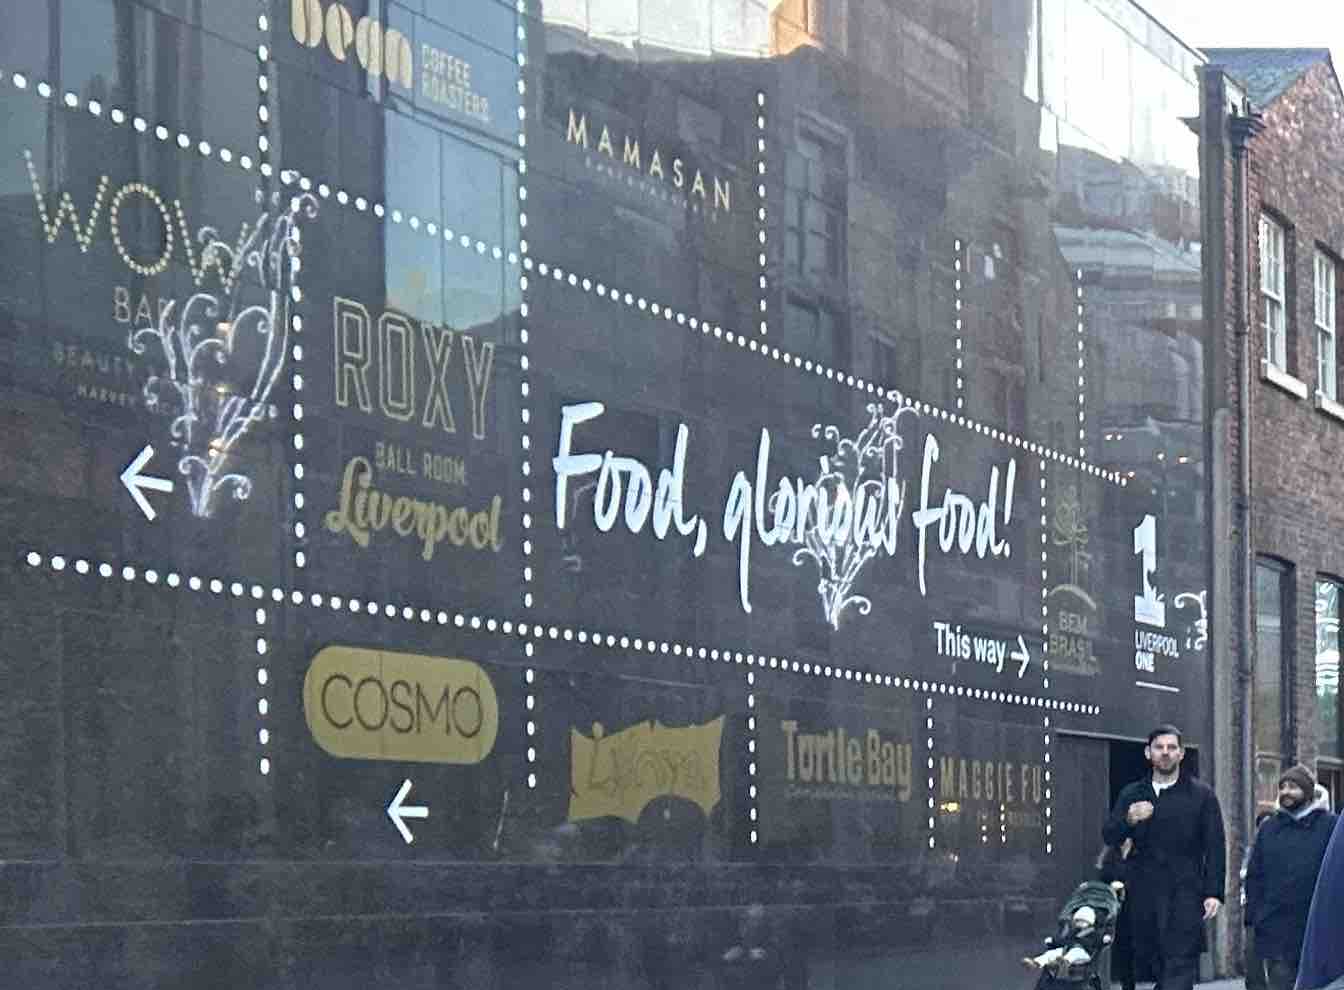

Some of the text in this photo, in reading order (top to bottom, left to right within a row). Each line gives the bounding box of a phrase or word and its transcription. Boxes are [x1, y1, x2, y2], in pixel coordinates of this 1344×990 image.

[567, 108, 731, 212] MAMASAN
[23, 149, 250, 295] WOW
[334, 295, 495, 442] ROXY
[375, 441, 468, 485] BALL ROOM
[324, 456, 503, 561] Liverpool
[553, 402, 1016, 614] Food, glorious food!
[933, 622, 1007, 673] This way
[1135, 629, 1179, 658] LIVERPOOL
[1135, 652, 1154, 673] ONE
[321, 673, 484, 738] COSMO
